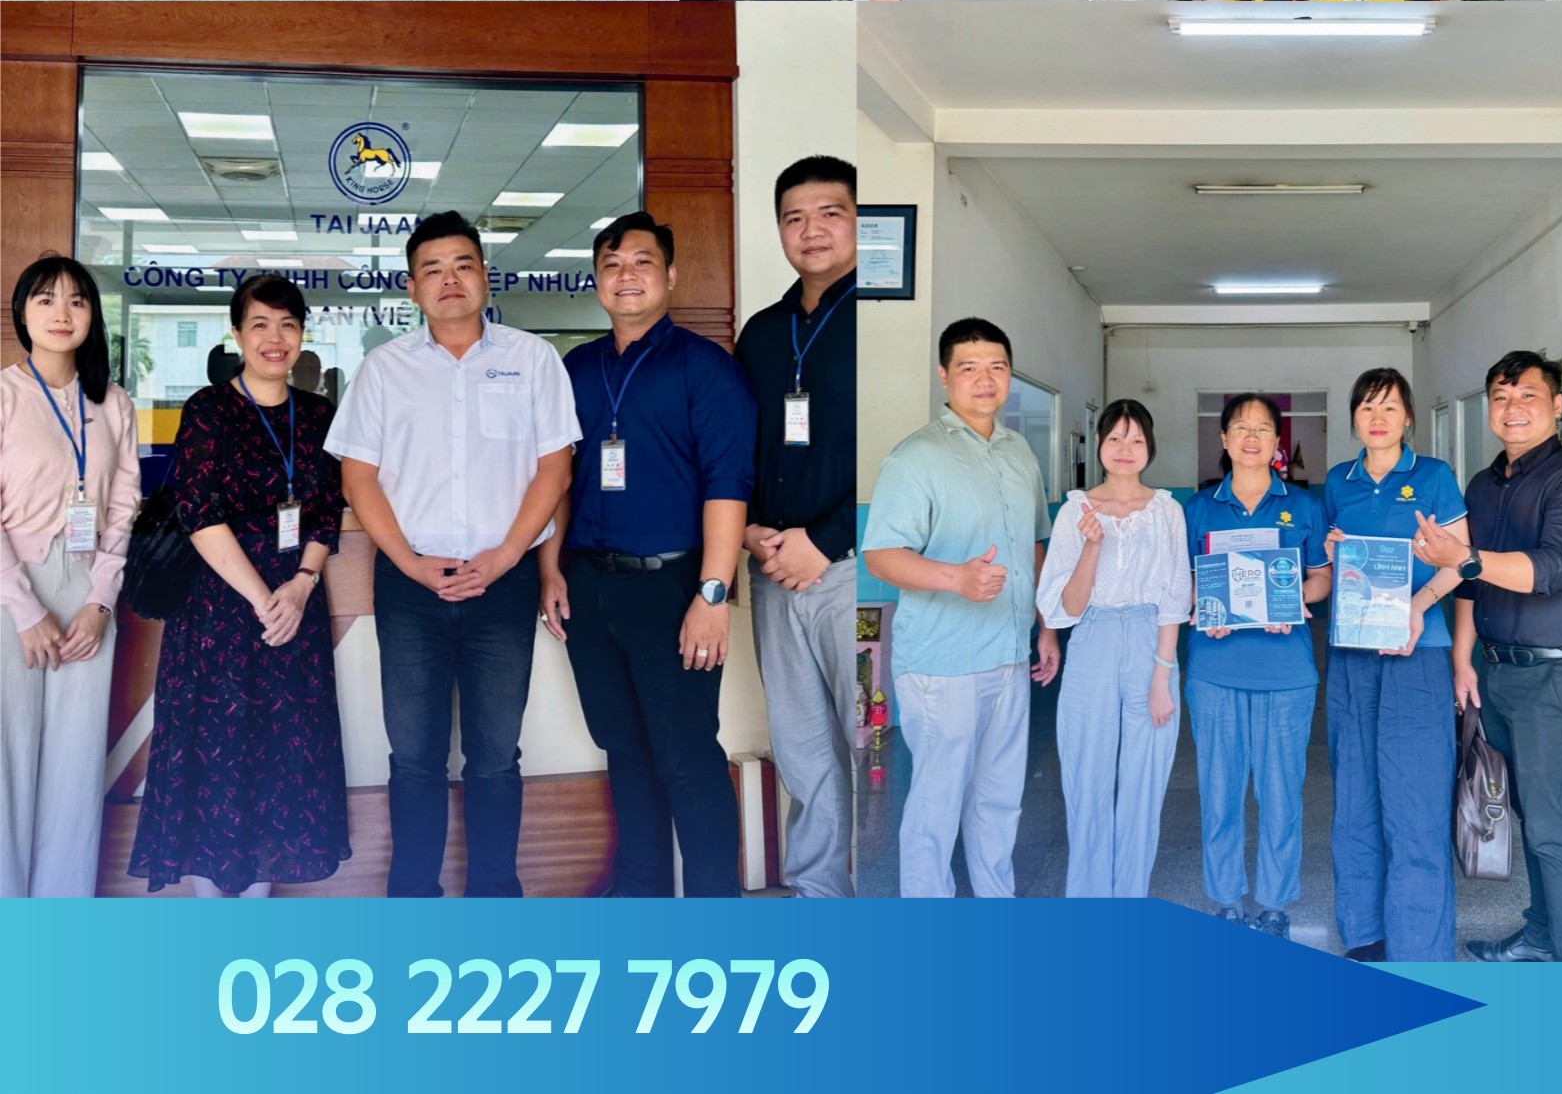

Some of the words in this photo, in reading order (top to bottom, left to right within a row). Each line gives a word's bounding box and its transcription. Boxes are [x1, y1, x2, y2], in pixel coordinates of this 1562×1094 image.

[344, 176, 366, 193] KING
[367, 178, 395, 194] HORSE
[123, 261, 204, 288] CÔNG
[214, 268, 248, 288] TY
[338, 264, 410, 290] CÔNG
[528, 270, 597, 299] NHỰA
